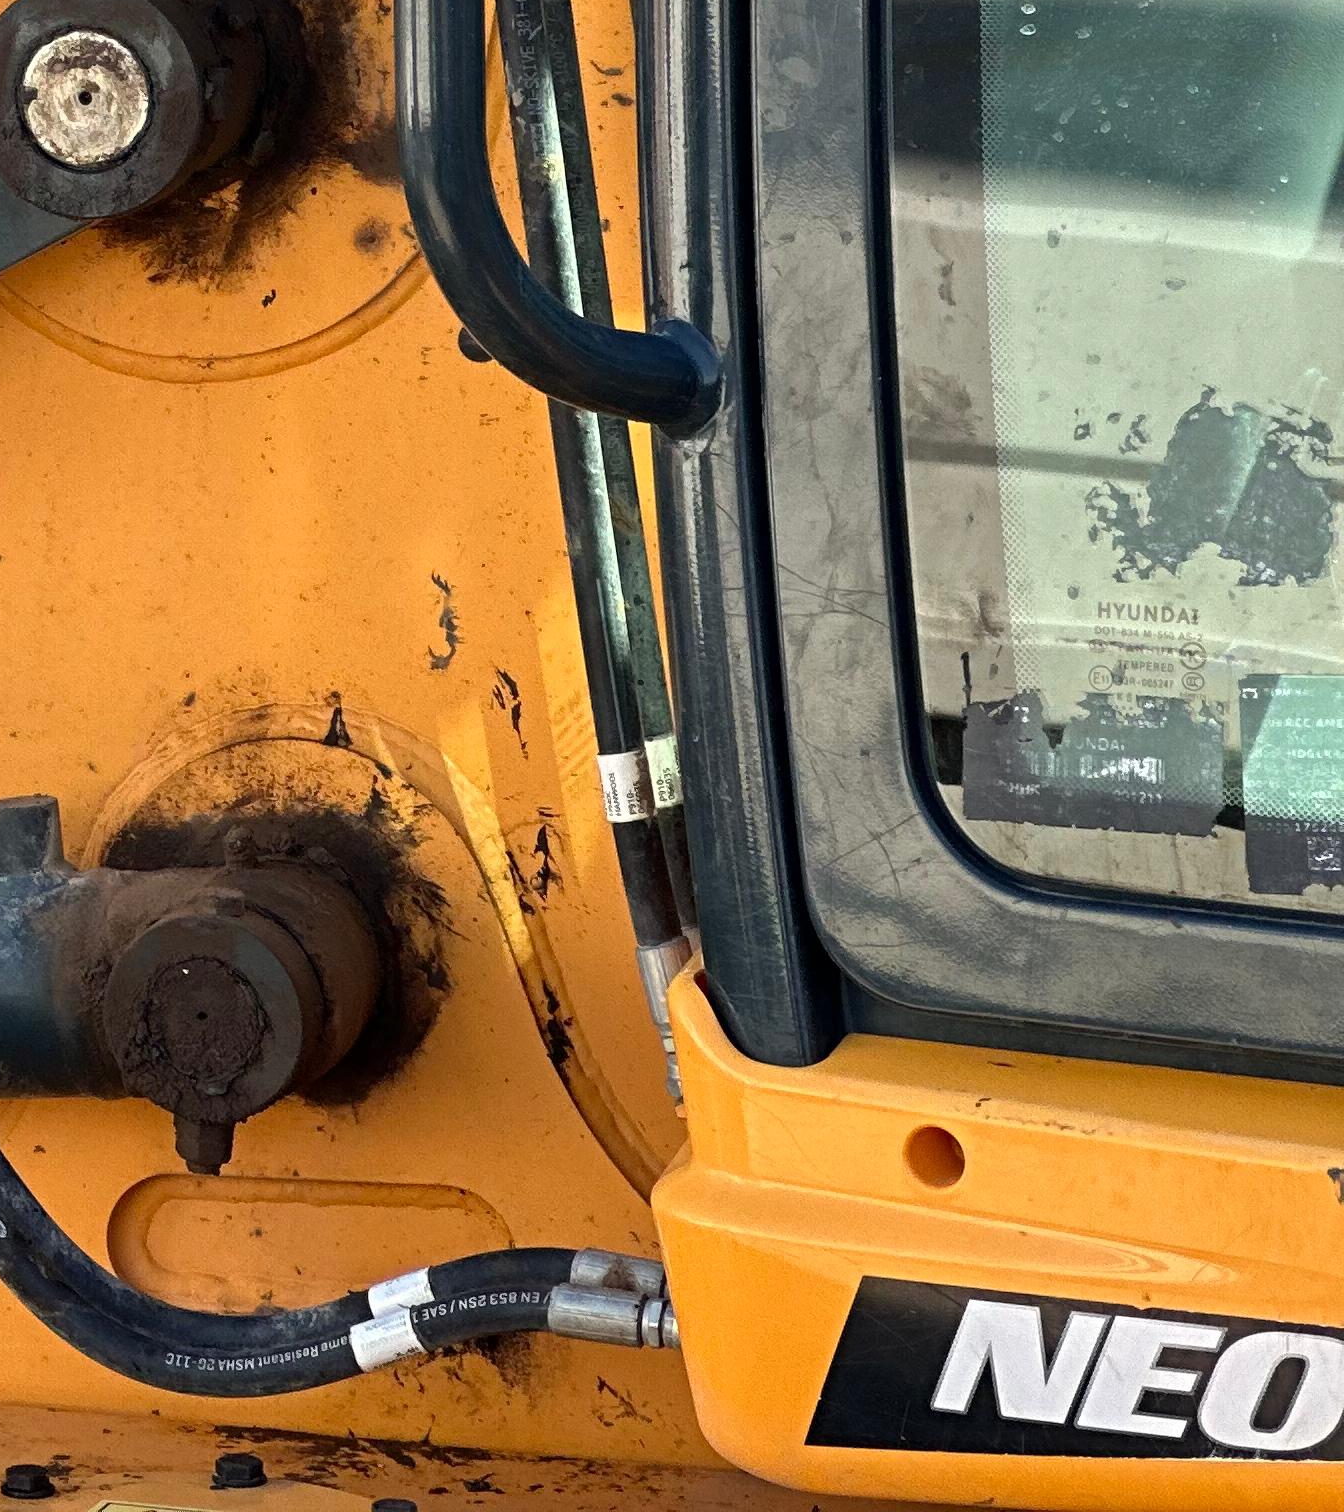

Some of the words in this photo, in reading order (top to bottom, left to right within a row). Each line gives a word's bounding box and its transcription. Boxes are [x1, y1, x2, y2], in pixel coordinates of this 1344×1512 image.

[520, 44, 544, 117] NO-SKIVE
[1097, 601, 1200, 625] HYUNDAI
[459, 1294, 486, 1311] 2SN
[490, 1292, 517, 1305] 853
[520, 1291, 540, 1304] EN
[422, 1303, 447, 1321] SAE
[321, 1335, 350, 1351] ame
[218, 1358, 255, 1371] MSHA
[258, 1345, 319, 1368] Resistant
[930, 1299, 1344, 1452] NEO
